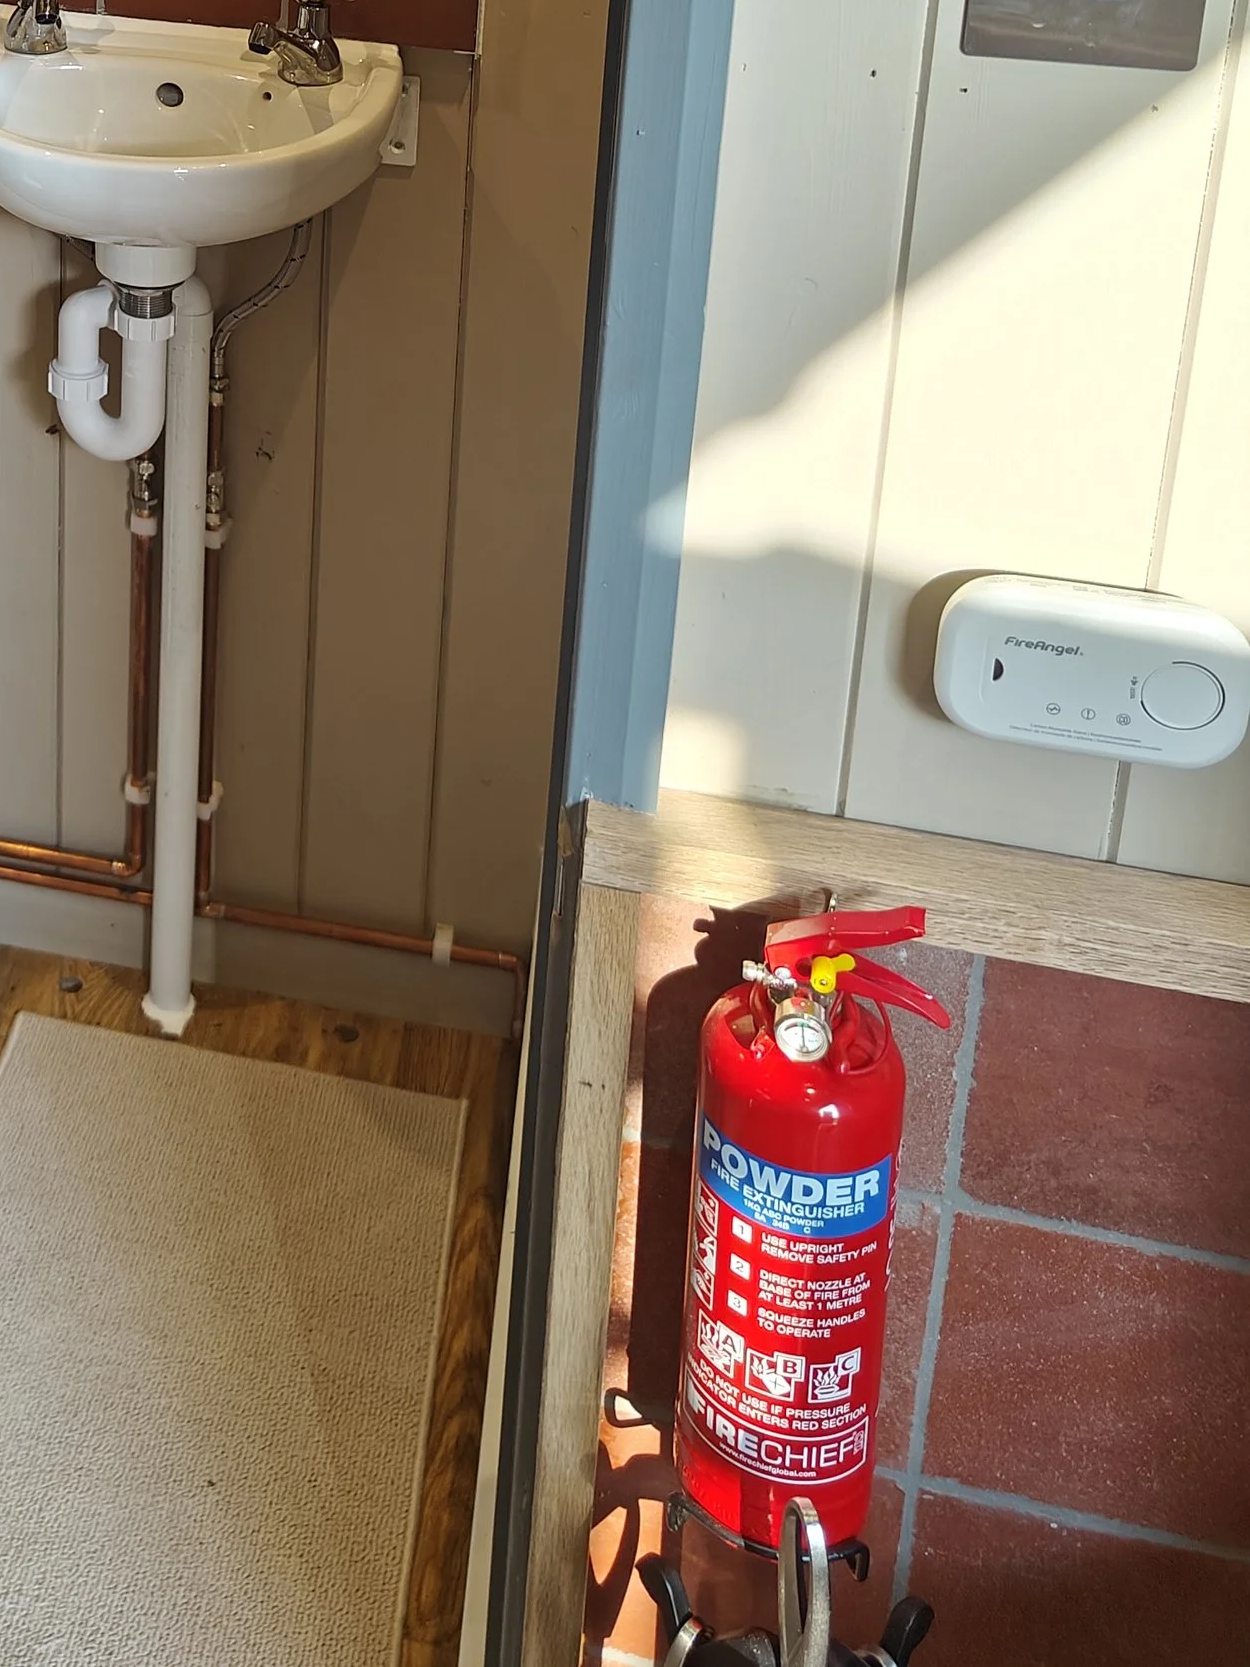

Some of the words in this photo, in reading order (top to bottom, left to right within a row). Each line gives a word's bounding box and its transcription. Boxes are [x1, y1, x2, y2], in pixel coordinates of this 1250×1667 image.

[1004, 636, 1081, 656] FireAngel
[704, 1118, 880, 1206] POWDER
[711, 1158, 740, 1192] FIRE
[743, 1184, 865, 1219] EXTINGUISHER
[783, 1214, 824, 1228] POWDER
[761, 1232, 787, 1248] USE
[790, 1241, 844, 1254] UPRIGHT
[761, 1243, 814, 1264] REMOVE
[816, 1248, 861, 1264] SAFETY
[861, 1240, 877, 1256] PIN
[758, 1279, 791, 1298] BASE
[794, 1290, 811, 1300] OF
[814, 1290, 840, 1300] FIRE
[841, 1279, 870, 1295] FROM
[759, 1268, 804, 1289] DIRECT
[807, 1277, 852, 1291] NOZZLE
[853, 1272, 866, 1282] AT
[758, 1291, 774, 1302] AT
[776, 1296, 814, 1311] LEAST
[826, 1293, 862, 1310] METRE
[757, 1307, 814, 1328] SQUEEZE
[817, 1308, 866, 1327] HANDLES
[757, 1317, 774, 1331] TO
[776, 1324, 831, 1338] OPERATE
[722, 1334, 737, 1353] A
[783, 1359, 798, 1374] B
[841, 1355, 855, 1371] C
[700, 1358, 714, 1379] DO
[715, 1375, 740, 1397] NOT
[741, 1392, 768, 1412] USE
[771, 1404, 783, 1414] IF
[786, 1402, 850, 1419] PRESSURE
[687, 1374, 854, 1469] FIRECHIEF
[738, 1402, 789, 1428] ENTERS
[792, 1419, 819, 1431] RED
[821, 1403, 867, 1430] SECTION
[719, 1441, 817, 1477] www.firechiefglobal.com
